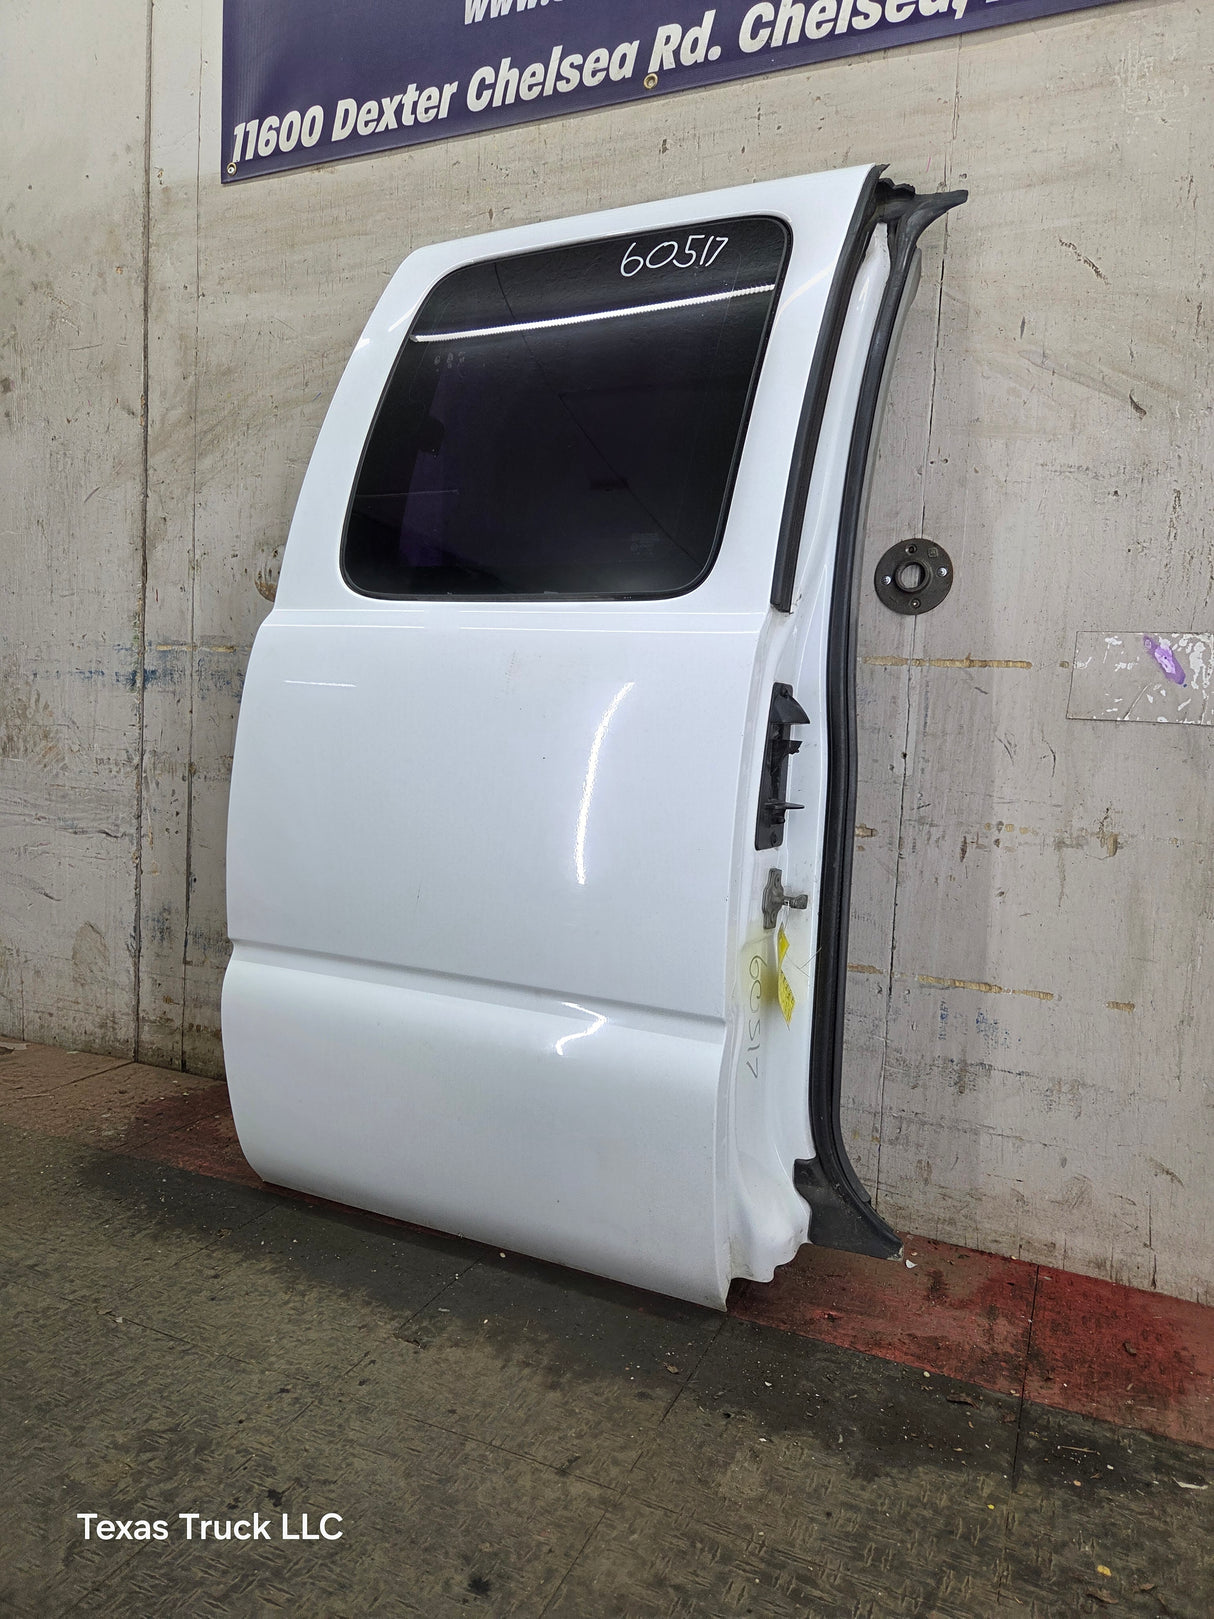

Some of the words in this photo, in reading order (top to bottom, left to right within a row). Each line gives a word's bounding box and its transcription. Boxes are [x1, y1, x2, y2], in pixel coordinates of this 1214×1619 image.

[232, 104, 324, 163] 11600
[331, 81, 459, 143] Dexter
[466, 40, 640, 113] Chelsea
[647, 9, 722, 71] Rd.
[620, 234, 729, 277] 60517
